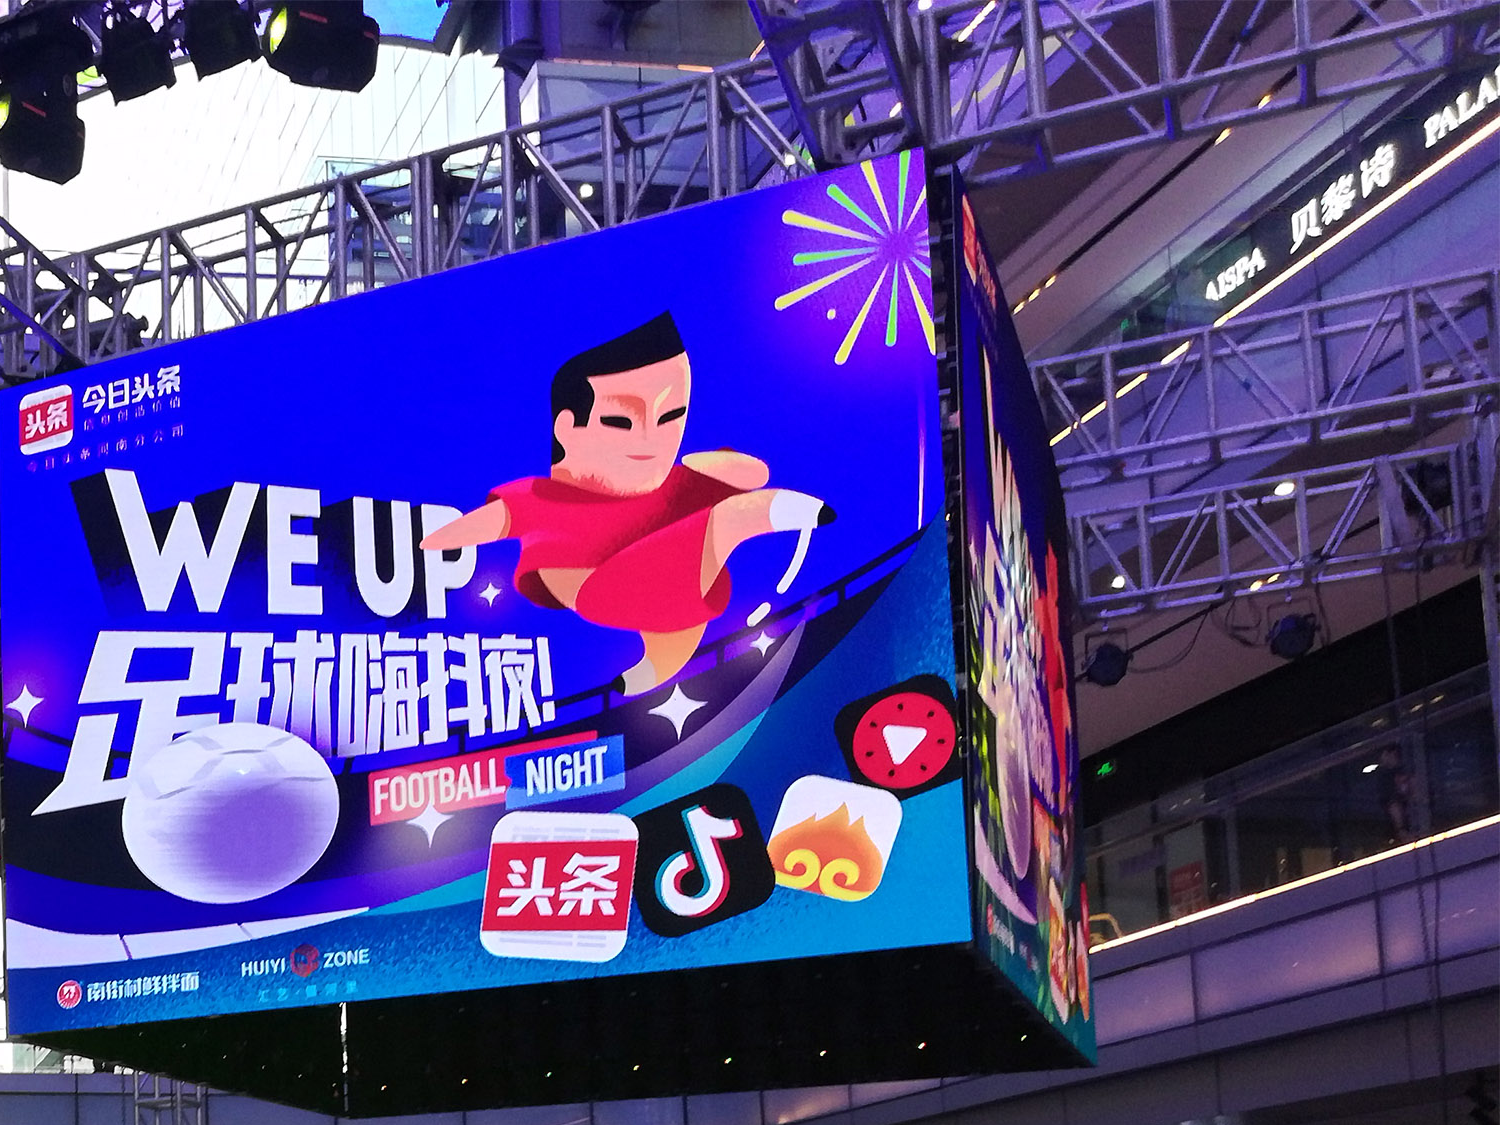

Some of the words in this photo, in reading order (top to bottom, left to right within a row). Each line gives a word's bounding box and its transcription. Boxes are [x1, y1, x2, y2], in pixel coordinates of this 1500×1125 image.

[82, 364, 181, 414] 今日头条
[25, 400, 68, 440] 头条
[105, 469, 323, 615] WE
[353, 497, 477, 619] UP
[373, 757, 506, 817] FOOTBALL
[525, 745, 609, 798] NIGHT
[496, 852, 621, 917] 头条
[241, 957, 286, 977] HUIYI
[324, 948, 369, 968] ZONE
